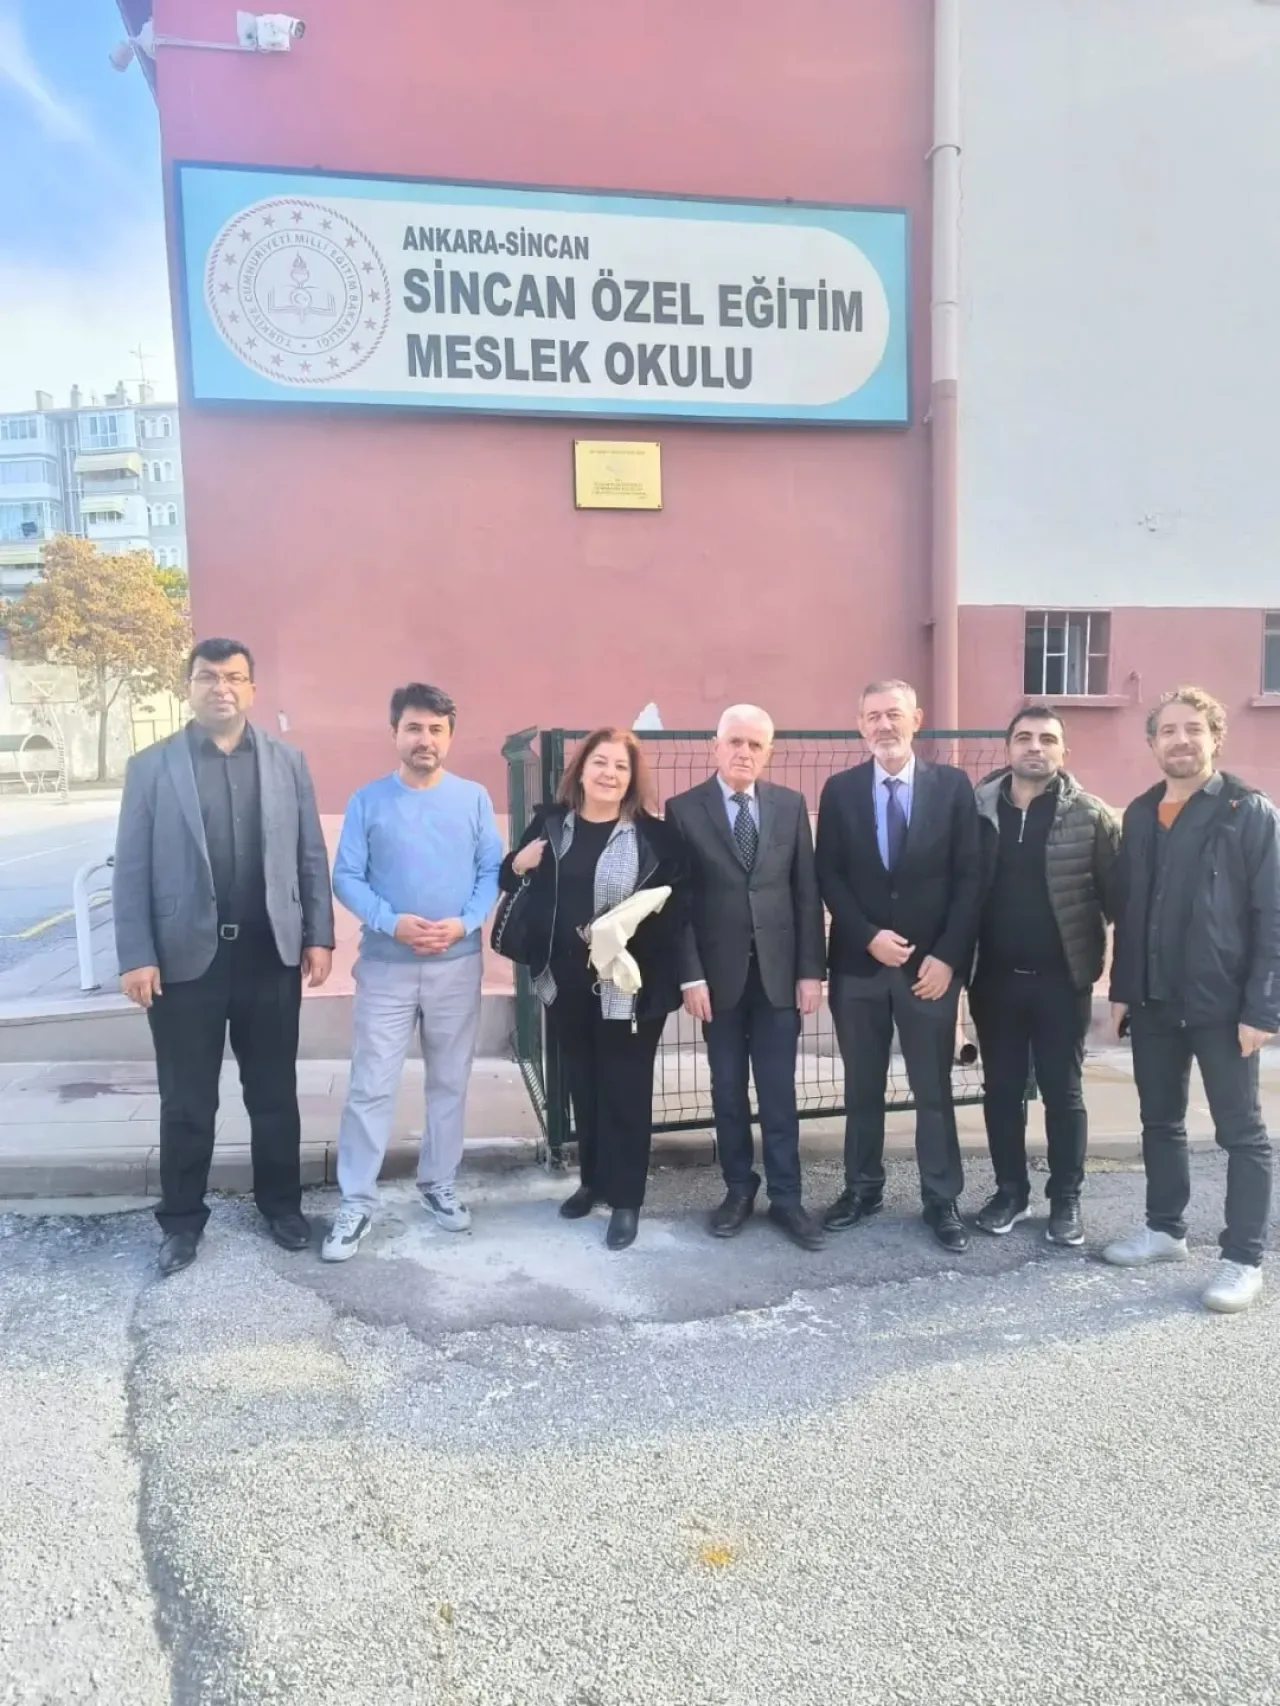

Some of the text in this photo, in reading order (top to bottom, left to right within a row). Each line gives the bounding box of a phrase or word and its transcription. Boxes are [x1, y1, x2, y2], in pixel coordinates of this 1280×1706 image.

[404, 226, 589, 260] ANKARA-SİNCAN
[403, 259, 863, 332] SİNCAN ÖZEL EĞİTİM
[407, 333, 752, 390] MESLEK OKULU
